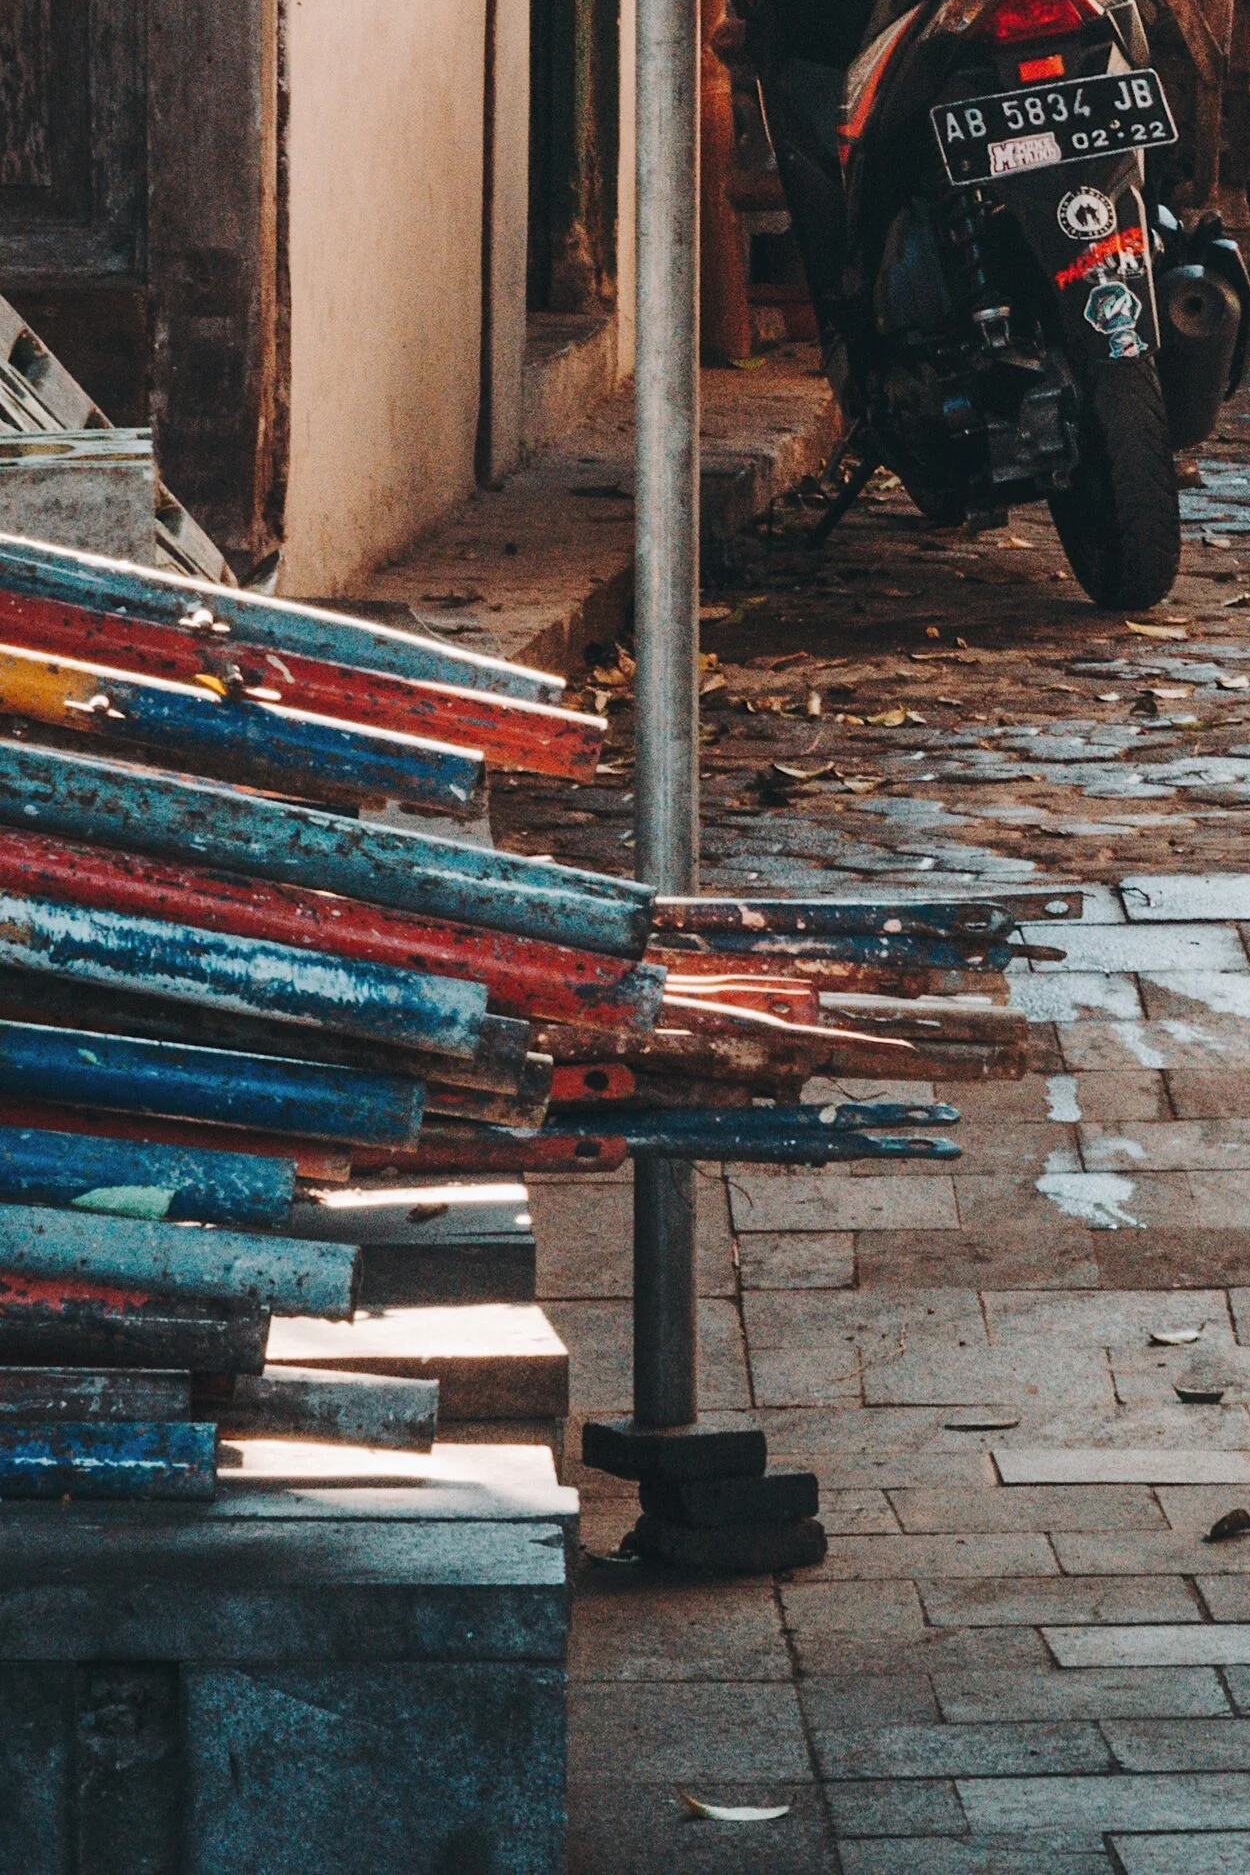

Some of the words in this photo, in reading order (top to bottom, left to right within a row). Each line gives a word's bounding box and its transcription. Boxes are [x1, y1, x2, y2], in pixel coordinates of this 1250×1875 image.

[947, 109, 987, 142] AB
[1002, 89, 1091, 130] 5834
[1114, 78, 1153, 112] JB
